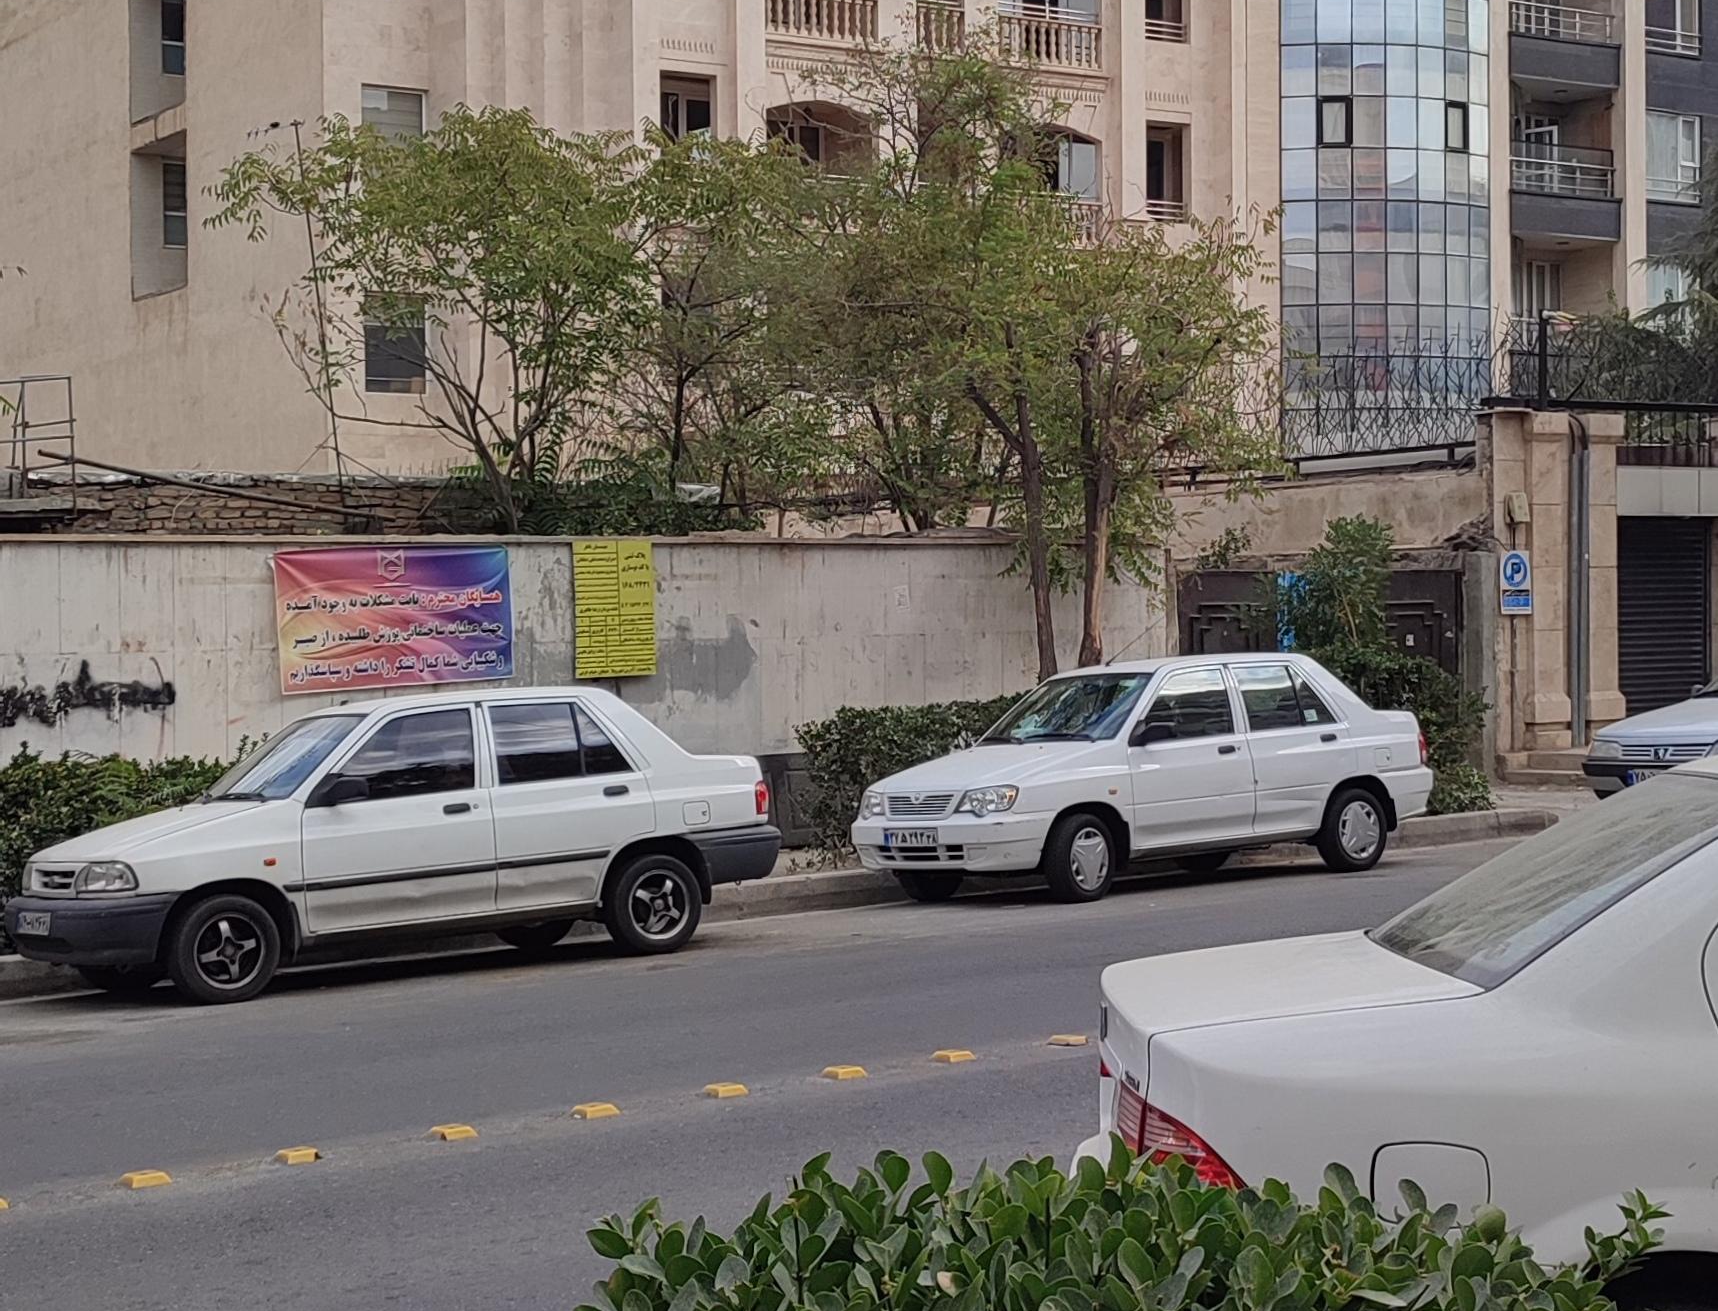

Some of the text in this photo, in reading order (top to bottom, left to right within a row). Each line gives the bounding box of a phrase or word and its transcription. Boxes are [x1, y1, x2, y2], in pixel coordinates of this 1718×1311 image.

[285, 595, 319, 611] آمده
[360, 593, 397, 608] مشکلات
[458, 589, 502, 608] همسایگان
[320, 630, 330, 647] از
[402, 623, 445, 643] ساختمانی
[448, 621, 479, 640] عملیات
[480, 622, 502, 638] جهت
[352, 658, 379, 675] داشته
[392, 656, 415, 677] تشکر
[417, 654, 440, 674] کمال
[442, 655, 459, 668] شما
